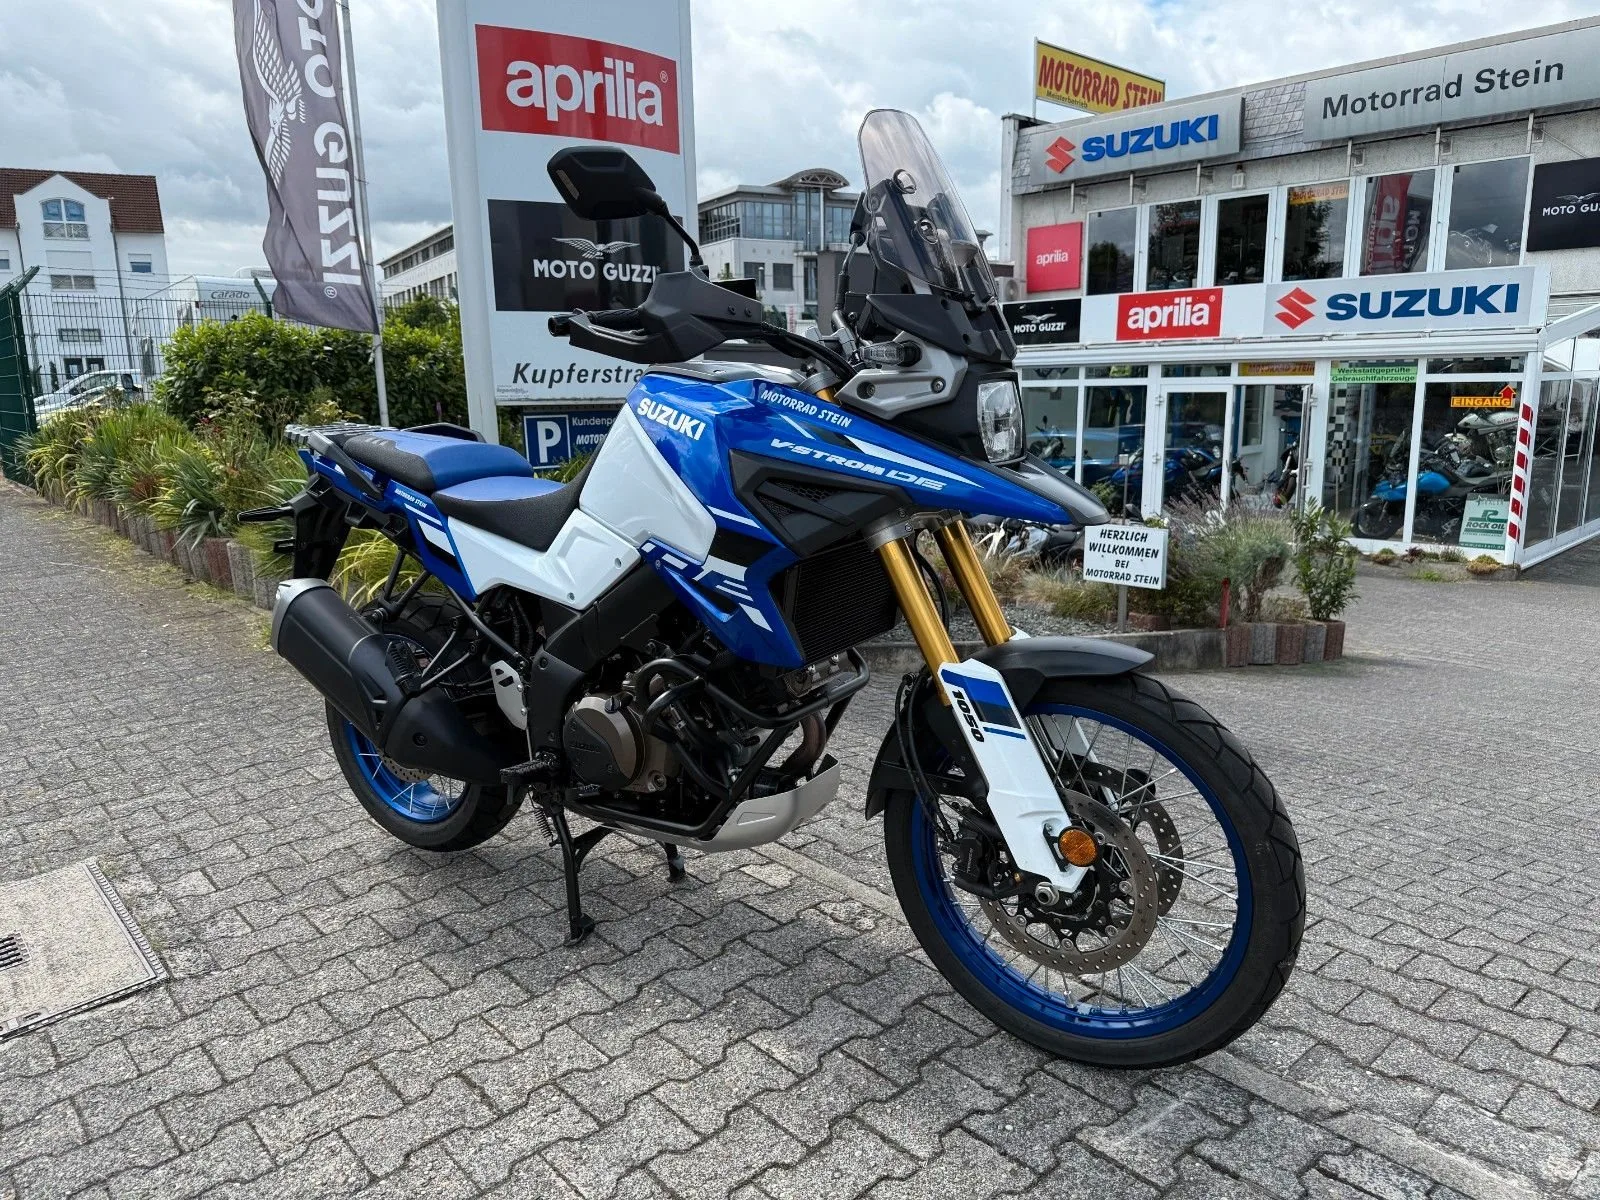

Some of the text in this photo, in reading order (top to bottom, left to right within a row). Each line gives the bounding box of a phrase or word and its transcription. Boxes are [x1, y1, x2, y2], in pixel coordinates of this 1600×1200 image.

[505, 56, 664, 127] aprilia
[1038, 55, 1120, 107] MOTORRAD
[1322, 59, 1565, 119] Motorrad Stein
[1046, 89, 1088, 108] Meisterbetrieb
[1082, 114, 1218, 162] SUZUKI
[1542, 202, 1600, 217] MOTO GU
[533, 258, 657, 284] MOTO GUZZI
[1036, 249, 1069, 267] aprilia
[1127, 296, 1210, 334] aprilia
[1325, 283, 1520, 321] SUZUKI
[1013, 322, 1065, 334] MOTO GUZZI
[512, 362, 644, 389] Kupferstra
[1331, 374, 1415, 382] Gebrauchtfahrzeuge
[1337, 367, 1411, 375] Werkstattgeprüfte
[760, 390, 852, 428] MOTORRAD STEIN
[1453, 397, 1511, 407] EINGANG
[637, 397, 706, 441] SUZUKI
[536, 420, 562, 464] P
[770, 438, 886, 476] V-STROM
[1100, 528, 1148, 543] HERZLICH
[1466, 521, 1490, 529] ROCK
[1089, 542, 1160, 558] WILLKOMMEN
[1086, 568, 1160, 585] MOTORRAD STEIN
[1114, 559, 1130, 569] BEI
[951, 689, 985, 743] 1050
